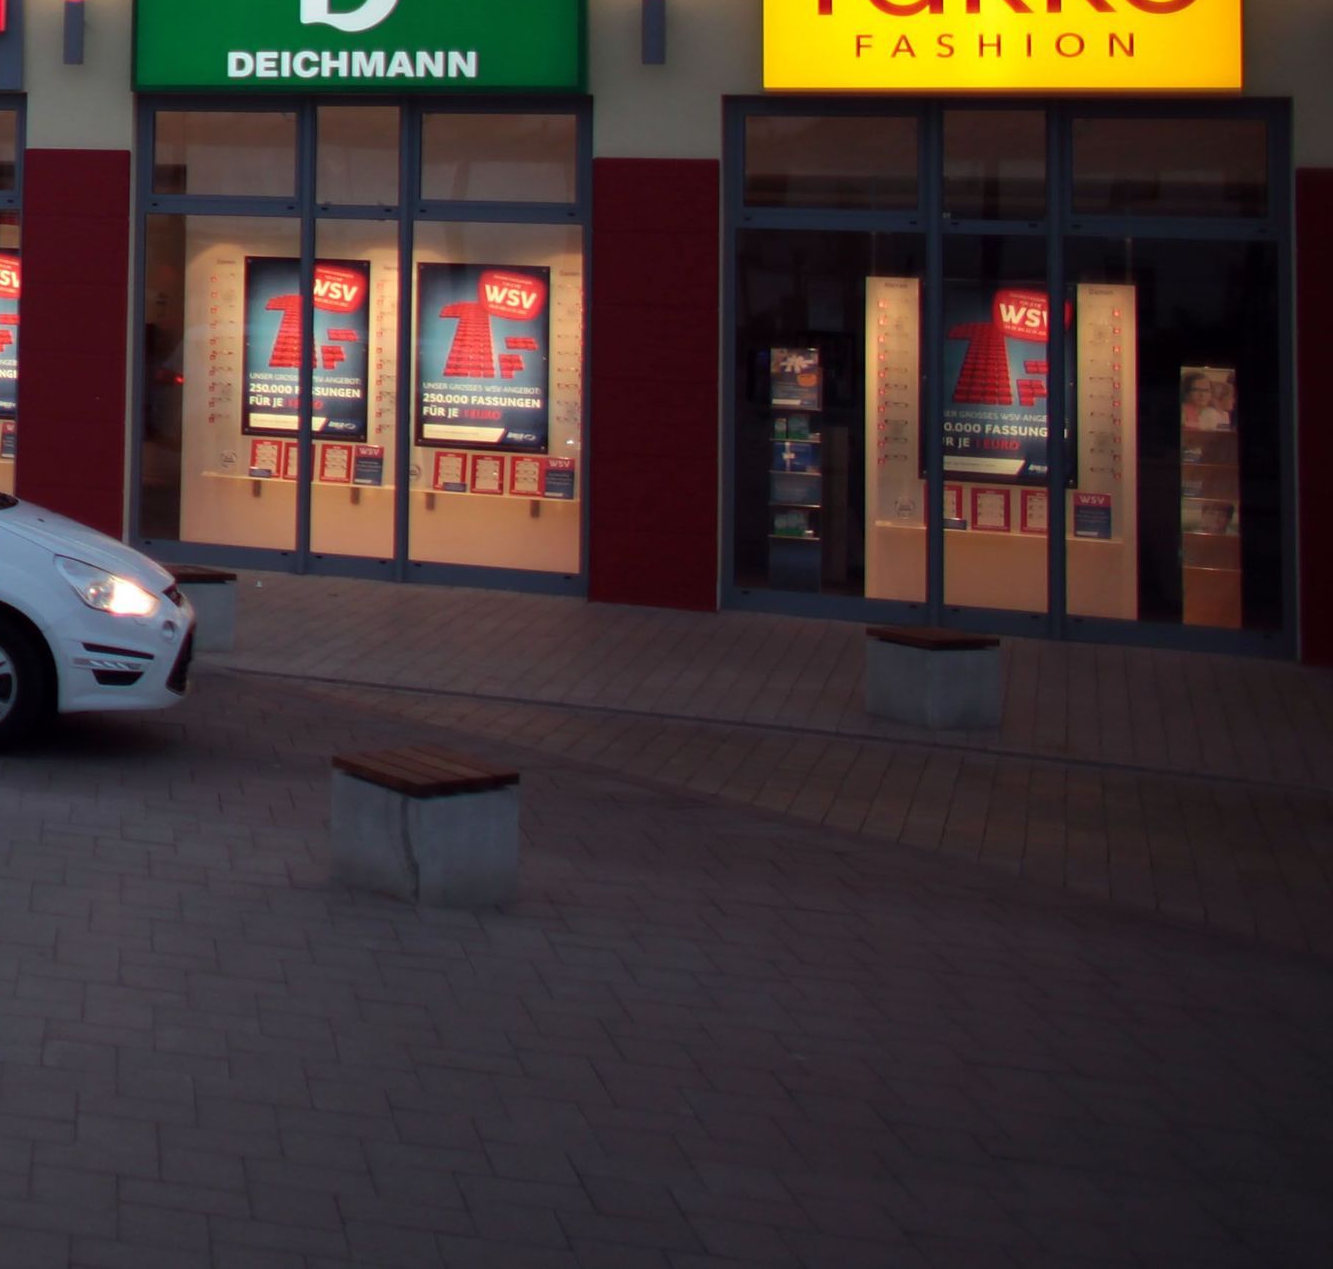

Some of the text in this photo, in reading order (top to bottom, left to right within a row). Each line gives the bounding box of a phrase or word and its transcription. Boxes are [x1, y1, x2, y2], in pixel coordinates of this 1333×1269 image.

[855, 32, 1137, 59] FASHION
[226, 49, 478, 79] DEICHMANN
[485, 283, 537, 310] WSV
[249, 383, 361, 398] 250.000 FSUNGEN
[422, 382, 448, 390] UNSER
[249, 395, 271, 406] FÜR
[272, 397, 284, 408] JE
[422, 393, 541, 408] 250.000 FASSUNGEN
[422, 405, 446, 417] FÜR
[447, 407, 459, 418] JE
[943, 422, 1068, 439] 0.000 FASSUNG
[958, 437, 971, 449] JE
[983, 439, 1021, 450] EURO
[549, 460, 571, 468] WSV
[1079, 495, 1105, 504] WSV
